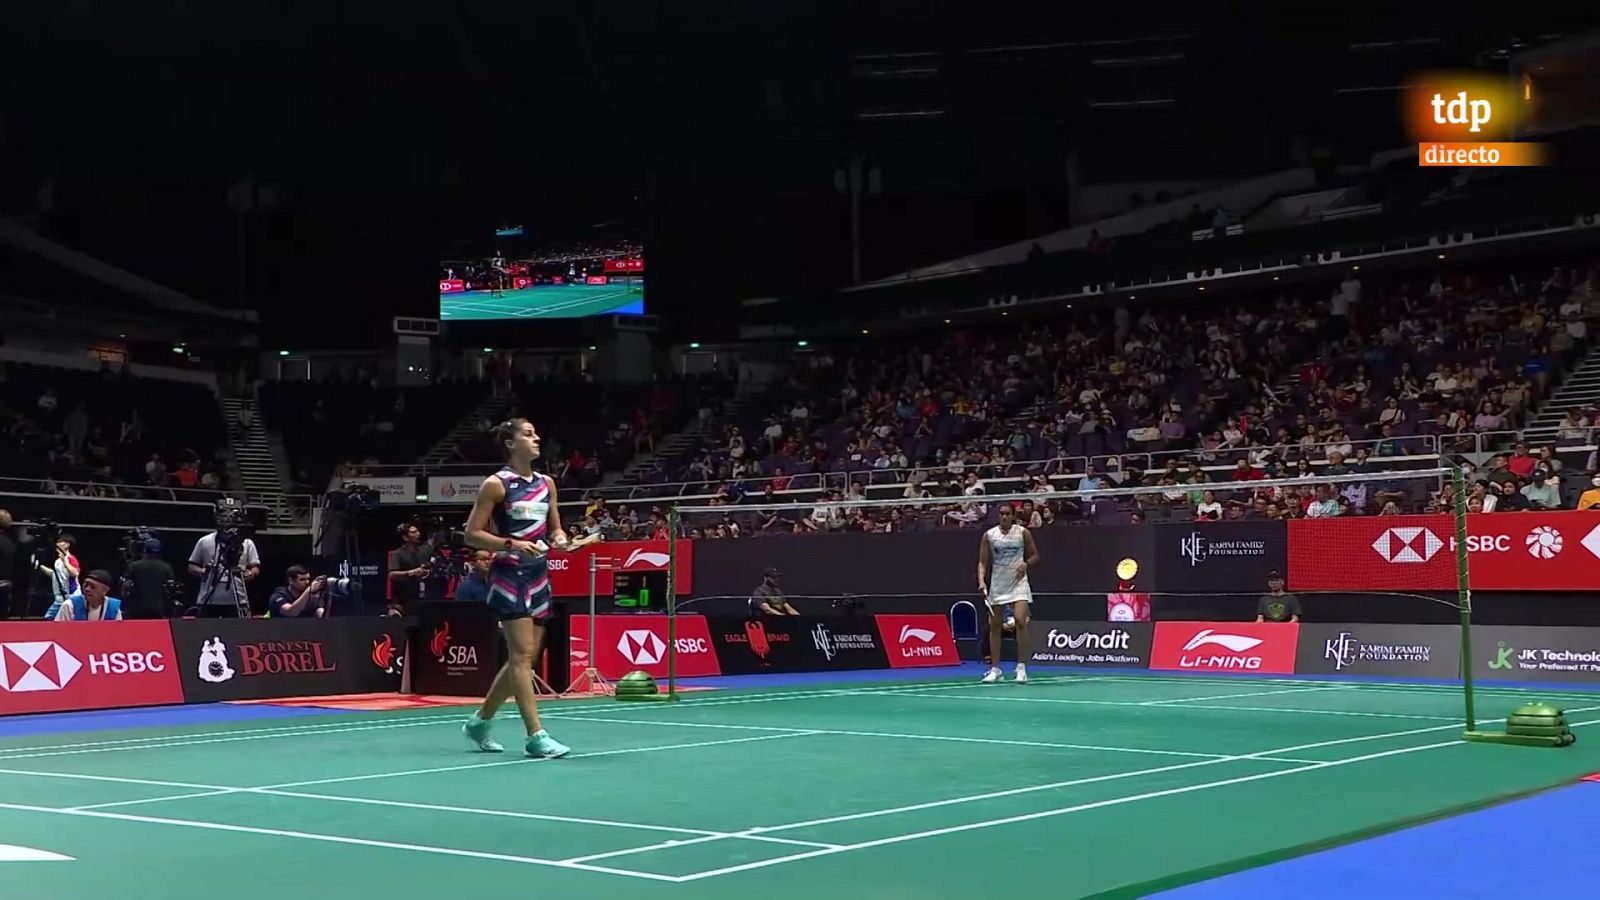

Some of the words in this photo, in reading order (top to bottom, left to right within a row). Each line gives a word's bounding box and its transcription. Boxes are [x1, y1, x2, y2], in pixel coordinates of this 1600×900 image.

[547, 559, 569, 570] SBC
[725, 634, 747, 642] EAGLE
[767, 633, 790, 642] BRAND
[1047, 629, 1130, 648] foundit
[259, 641, 312, 652] ERNEST
[902, 646, 942, 657] LI-NING
[1360, 644, 1392, 653] KARIM
[1394, 646, 1430, 654] FAMILY
[237, 642, 336, 675] BOREL
[447, 646, 478, 664] SBA
[1055, 653, 1084, 663] Leading
[1085, 654, 1104, 662] Jobs
[1105, 654, 1139, 662] Platform
[1360, 653, 1430, 661] FOUNDATION
[1517, 649, 1538, 660] JK
[89, 651, 165, 674] HSBC
[1180, 655, 1262, 668] LI-NING
